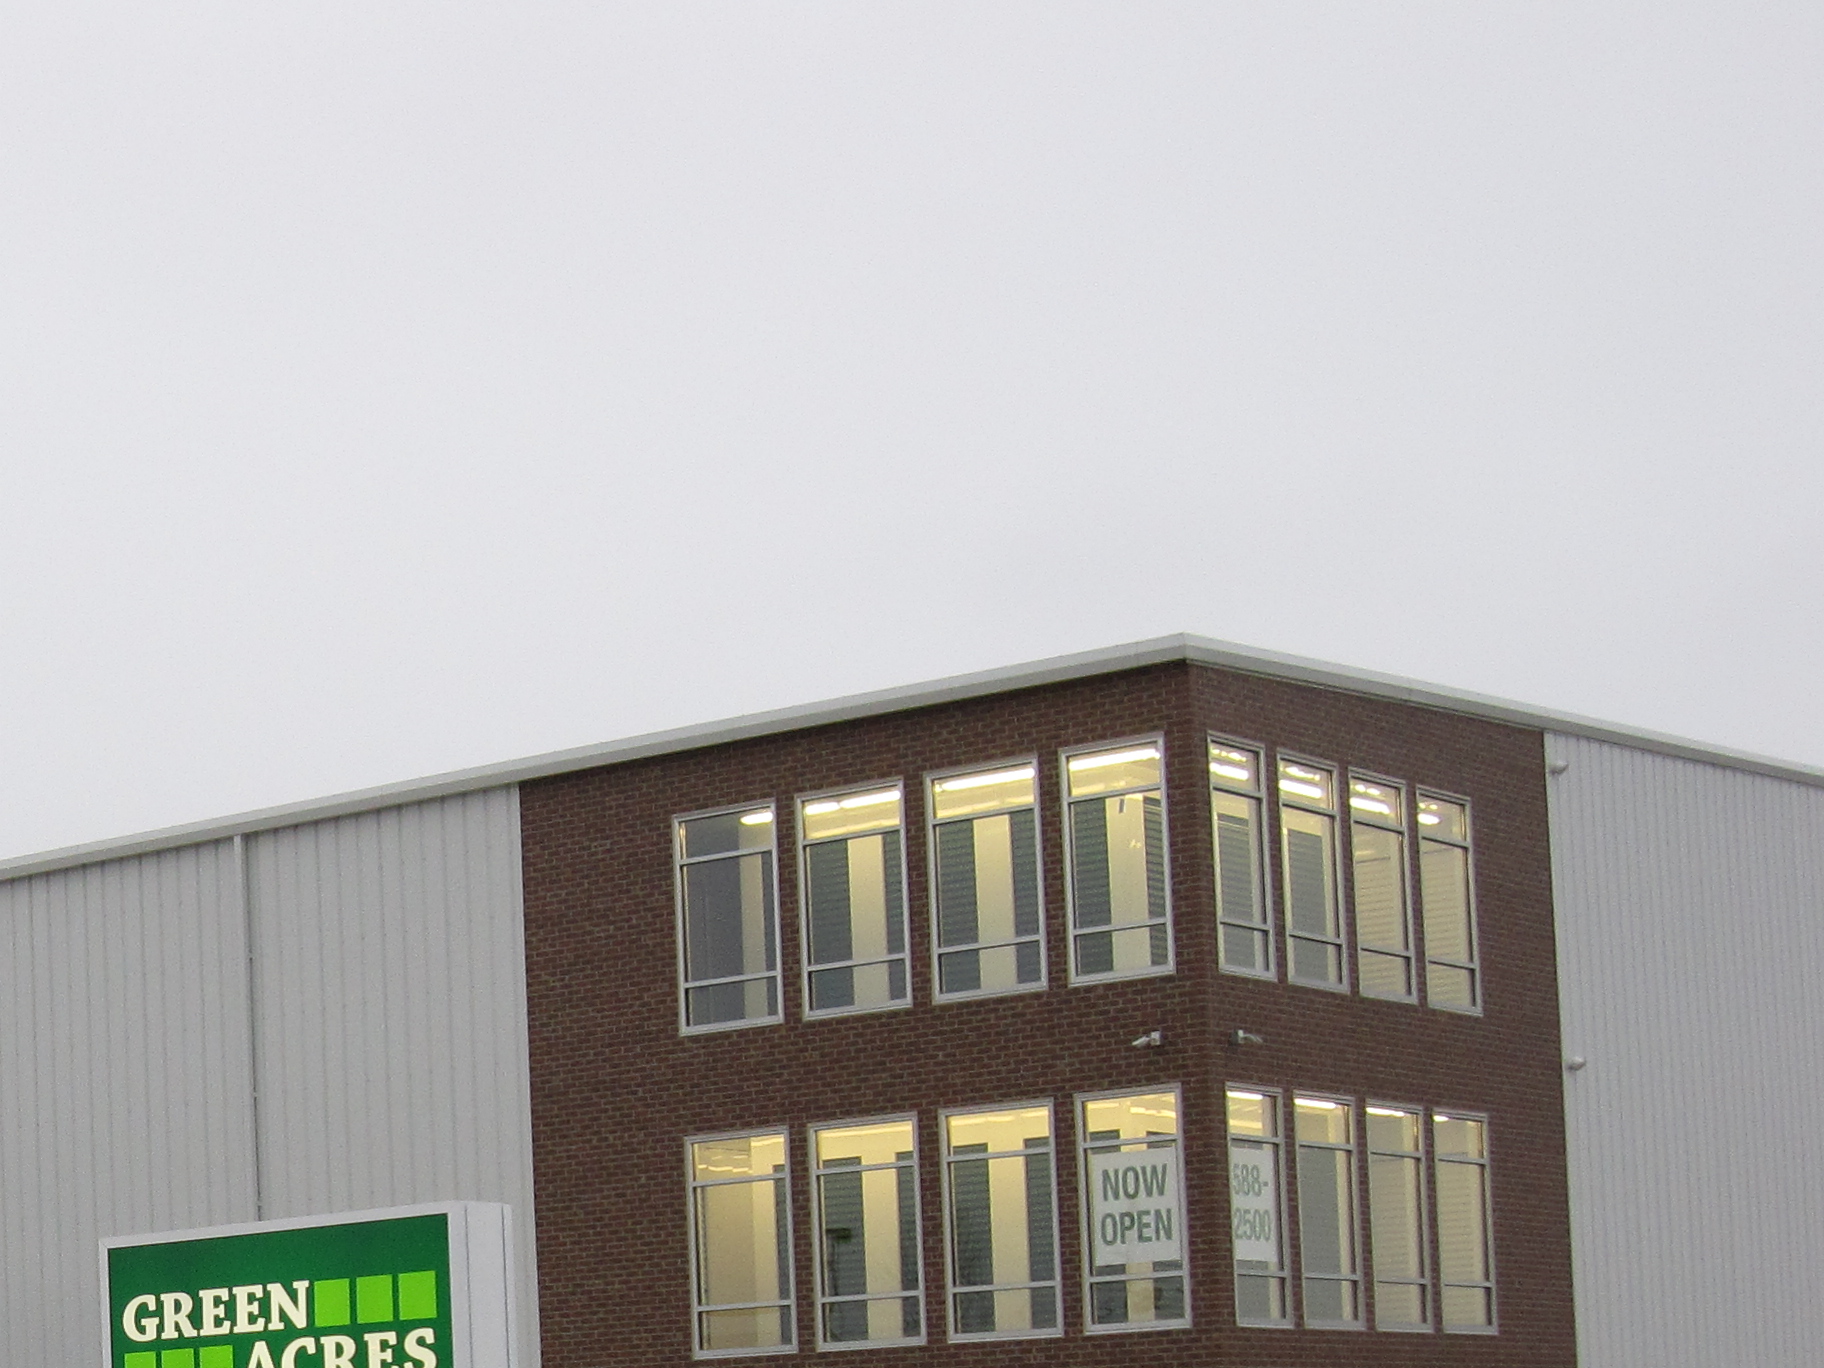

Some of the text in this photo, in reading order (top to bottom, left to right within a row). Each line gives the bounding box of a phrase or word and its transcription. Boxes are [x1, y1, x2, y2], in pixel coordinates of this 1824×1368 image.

[1101, 1163, 1168, 1201] NOW
[1100, 1207, 1173, 1246] OPEN
[1233, 1207, 1271, 1242] 2500
[122, 1280, 310, 1342] GREEN
